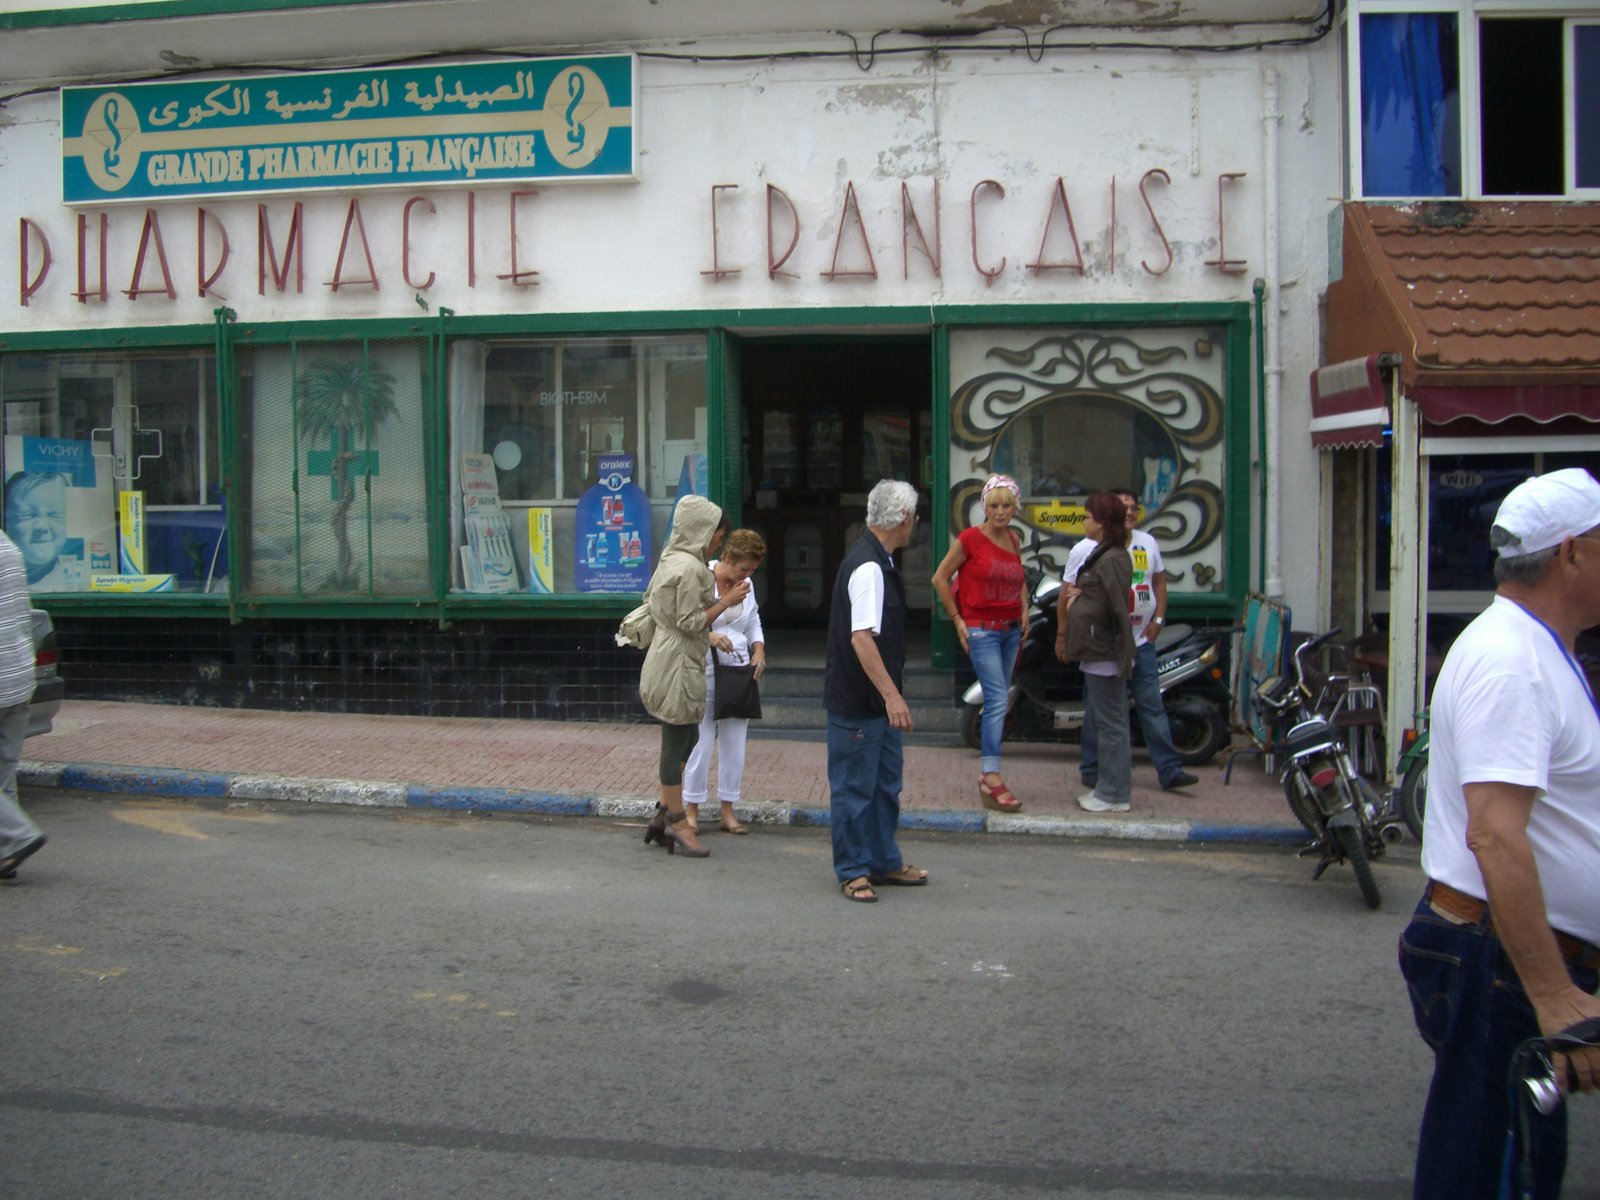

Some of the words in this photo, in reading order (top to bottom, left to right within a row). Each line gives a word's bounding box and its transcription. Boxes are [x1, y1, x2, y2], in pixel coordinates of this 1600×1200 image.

[148, 83, 250, 128] الكبرى
[265, 78, 390, 120] الفرنسية
[404, 71, 535, 111] الصيدلية
[147, 150, 244, 186] GRANDE
[248, 141, 393, 181] PHARMACIE
[397, 135, 535, 178] FRANÇAISE
[20, 191, 540, 307] PHARMACIE
[38, 444, 80, 457] VICHY
[600, 460, 631, 470] oralex
